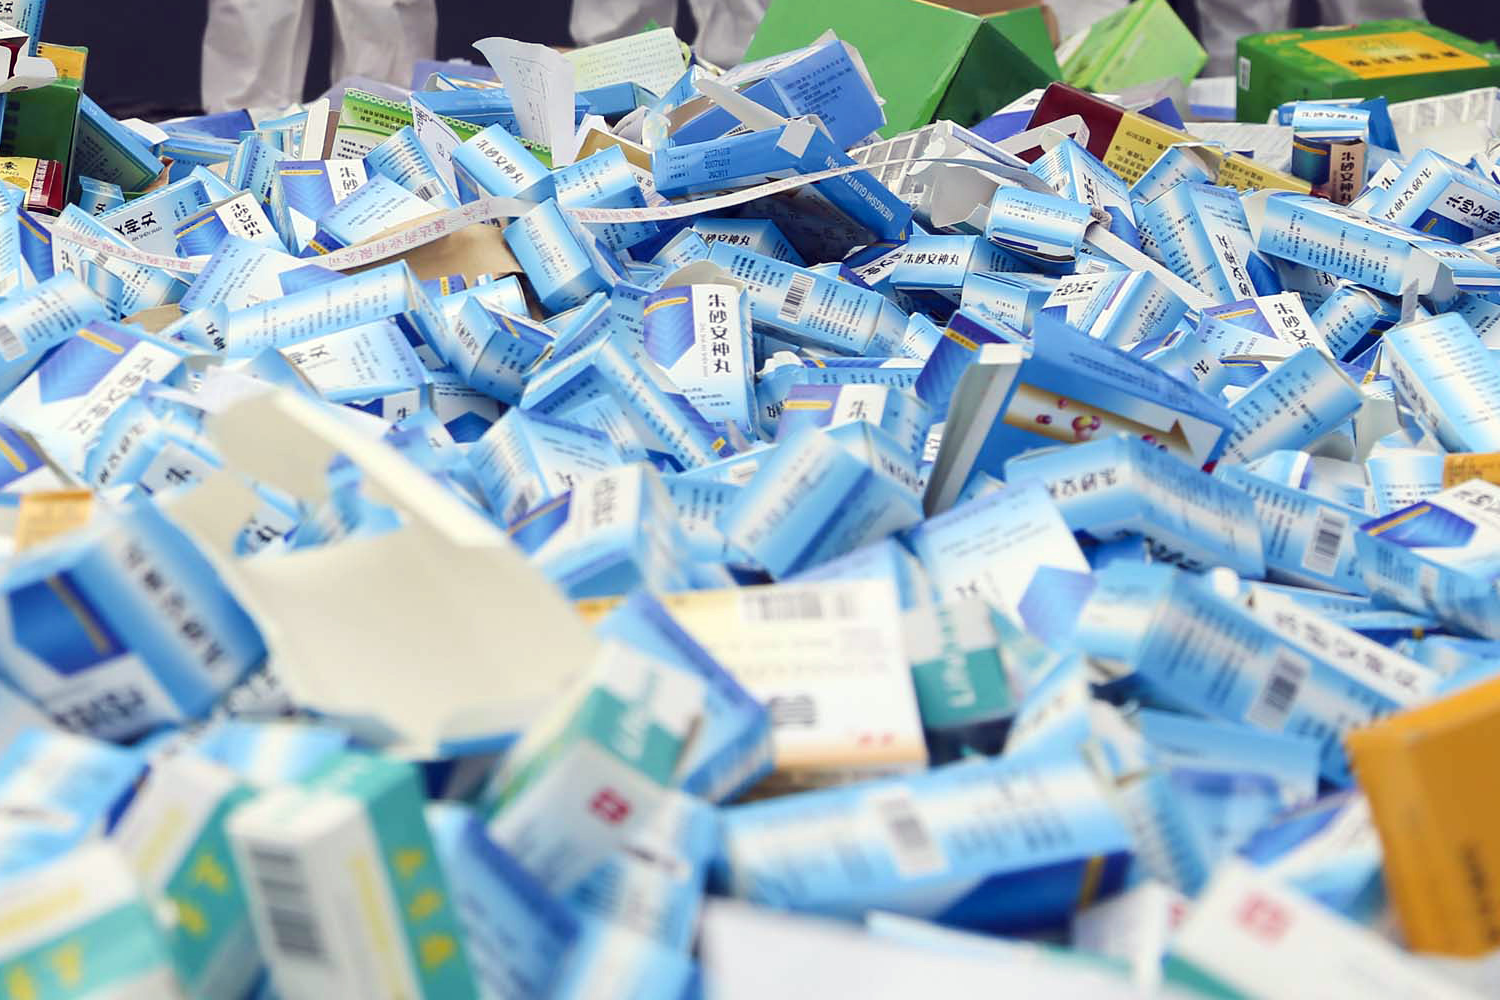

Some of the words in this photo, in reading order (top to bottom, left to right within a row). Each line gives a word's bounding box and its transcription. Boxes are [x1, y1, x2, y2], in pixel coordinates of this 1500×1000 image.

[841, 172, 868, 197] GUNTA
[866, 192, 895, 222] MENGSHI
[903, 252, 960, 267] 朱砂安神丸
[708, 293, 732, 374] 朱砂安神丸
